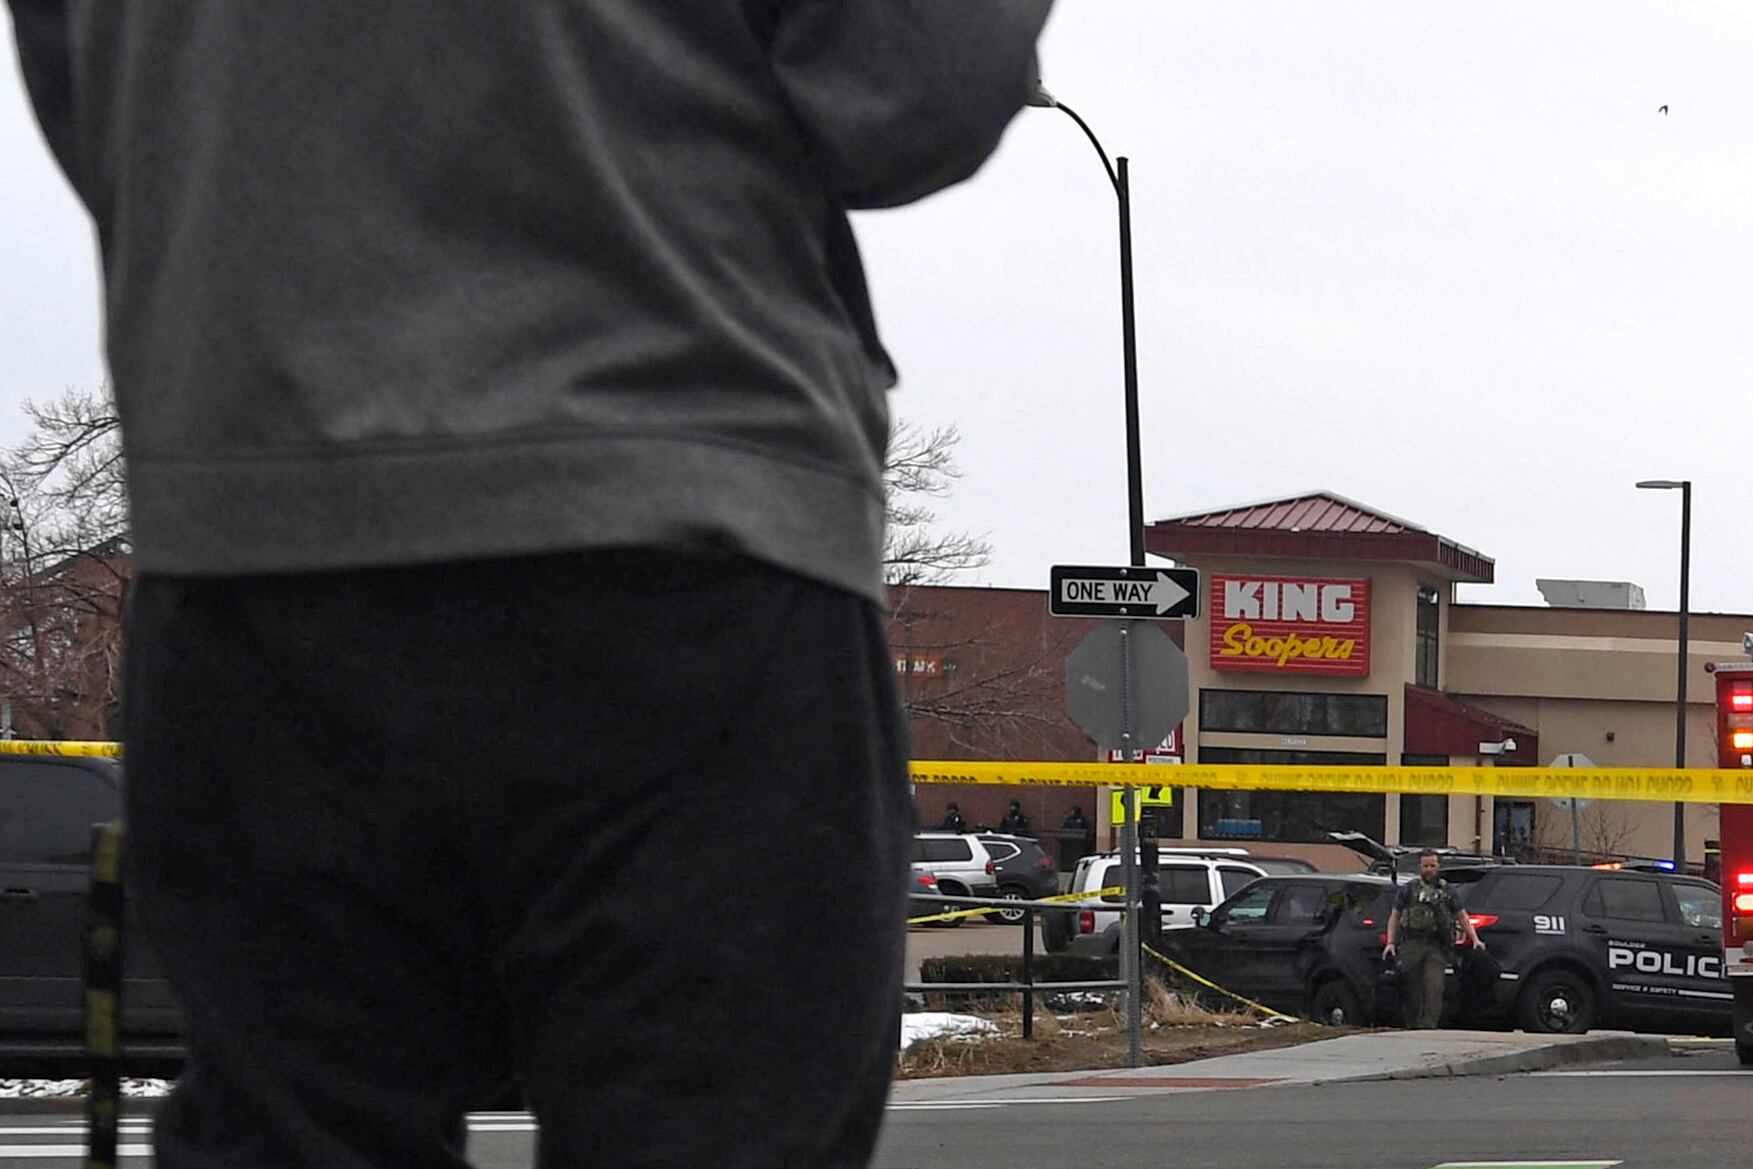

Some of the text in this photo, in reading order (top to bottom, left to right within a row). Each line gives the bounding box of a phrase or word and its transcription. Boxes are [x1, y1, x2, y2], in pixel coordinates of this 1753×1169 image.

[1067, 582, 1153, 602] ONE WAY
[1224, 581, 1355, 623] KING
[1220, 624, 1355, 667] Soopers
[1534, 916, 1565, 931] 911
[1608, 948, 1726, 979] POLIC
